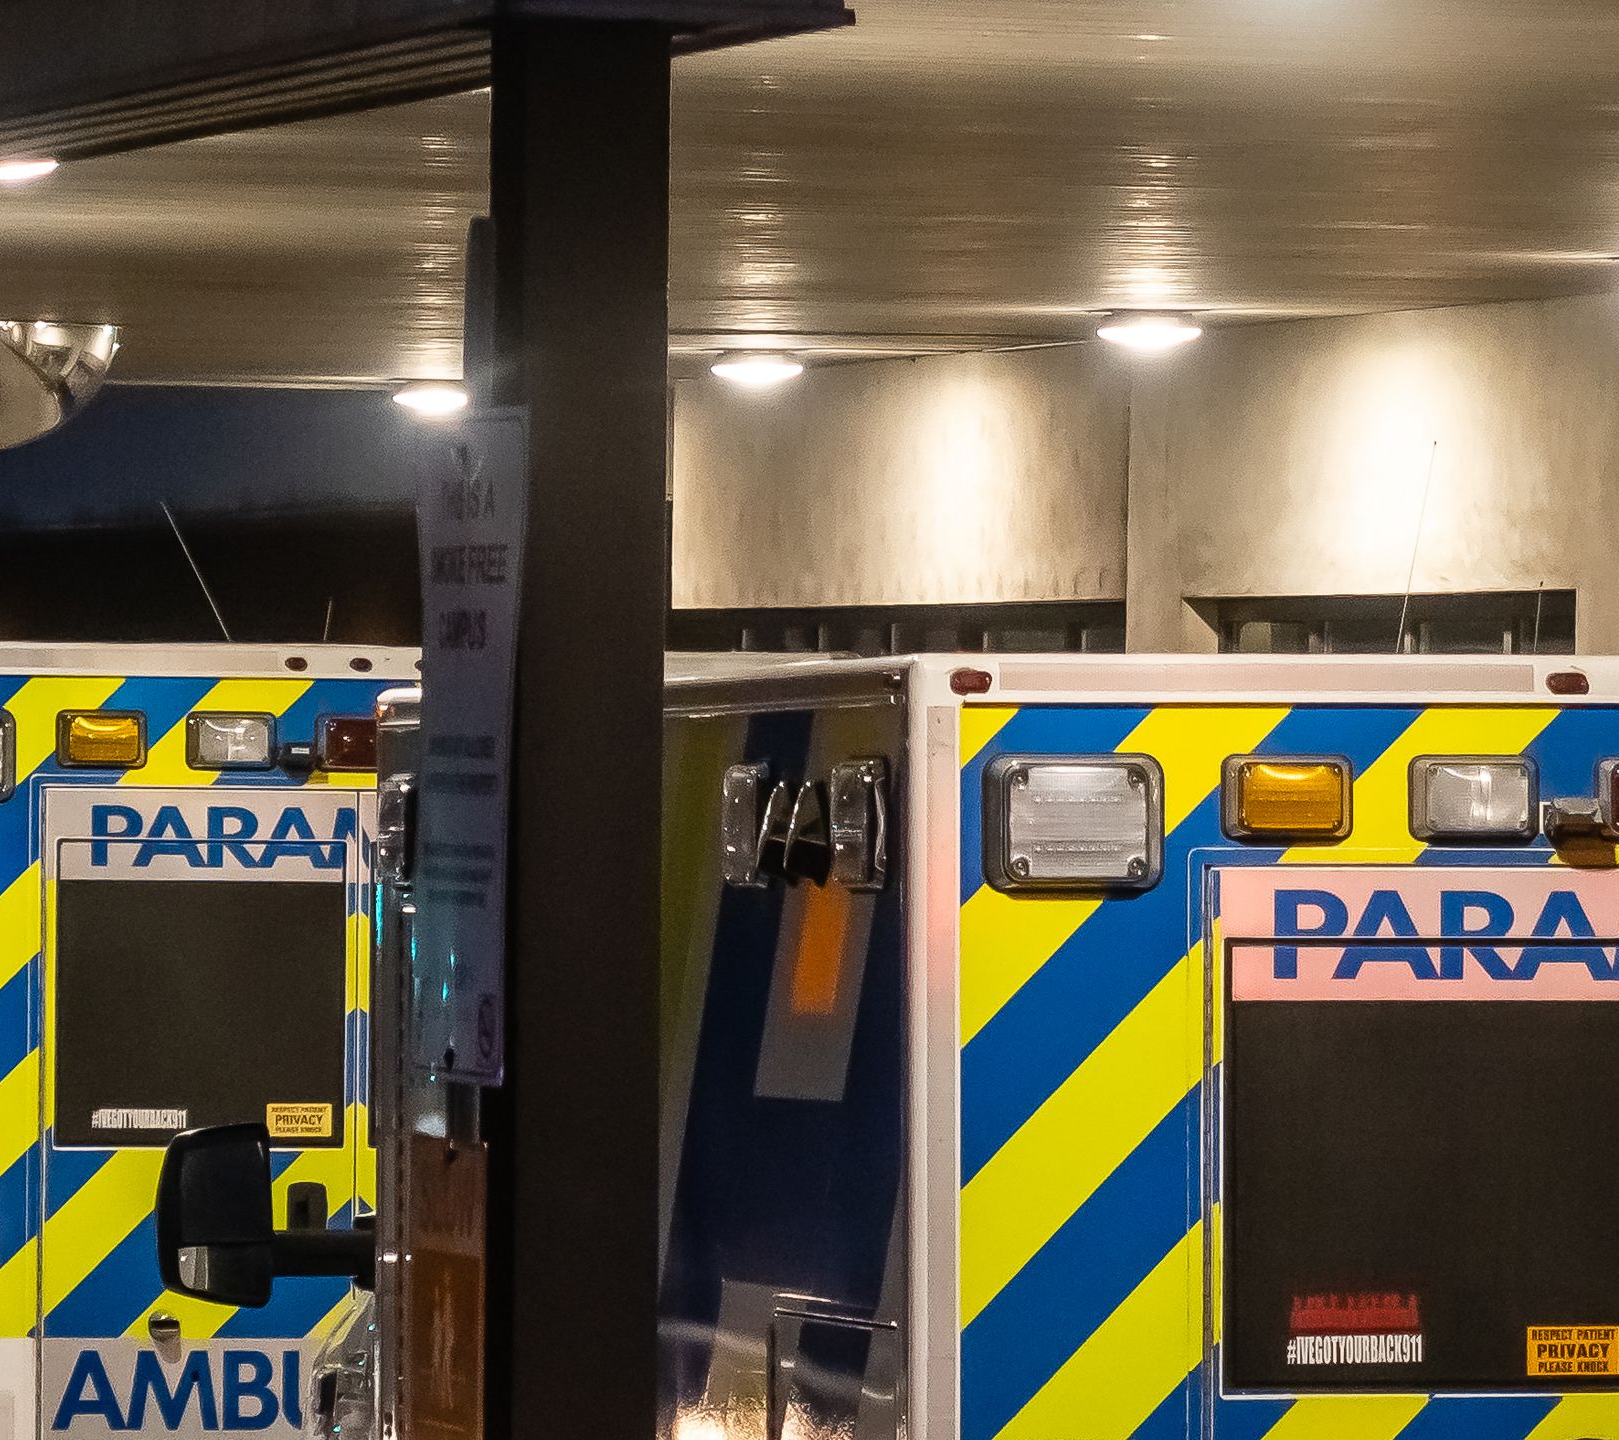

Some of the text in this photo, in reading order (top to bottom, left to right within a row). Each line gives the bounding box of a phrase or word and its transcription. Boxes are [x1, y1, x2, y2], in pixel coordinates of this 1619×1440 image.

[275, 1114, 324, 1126] PRIVACY
[1531, 1328, 1615, 1341] RESPECT PATIENT
[1287, 1333, 1423, 1366] #IVEGOTYOURBACK911
[1537, 1343, 1610, 1359] PRIVACY
[1538, 1361, 1609, 1373] PLEASE KNOCK
